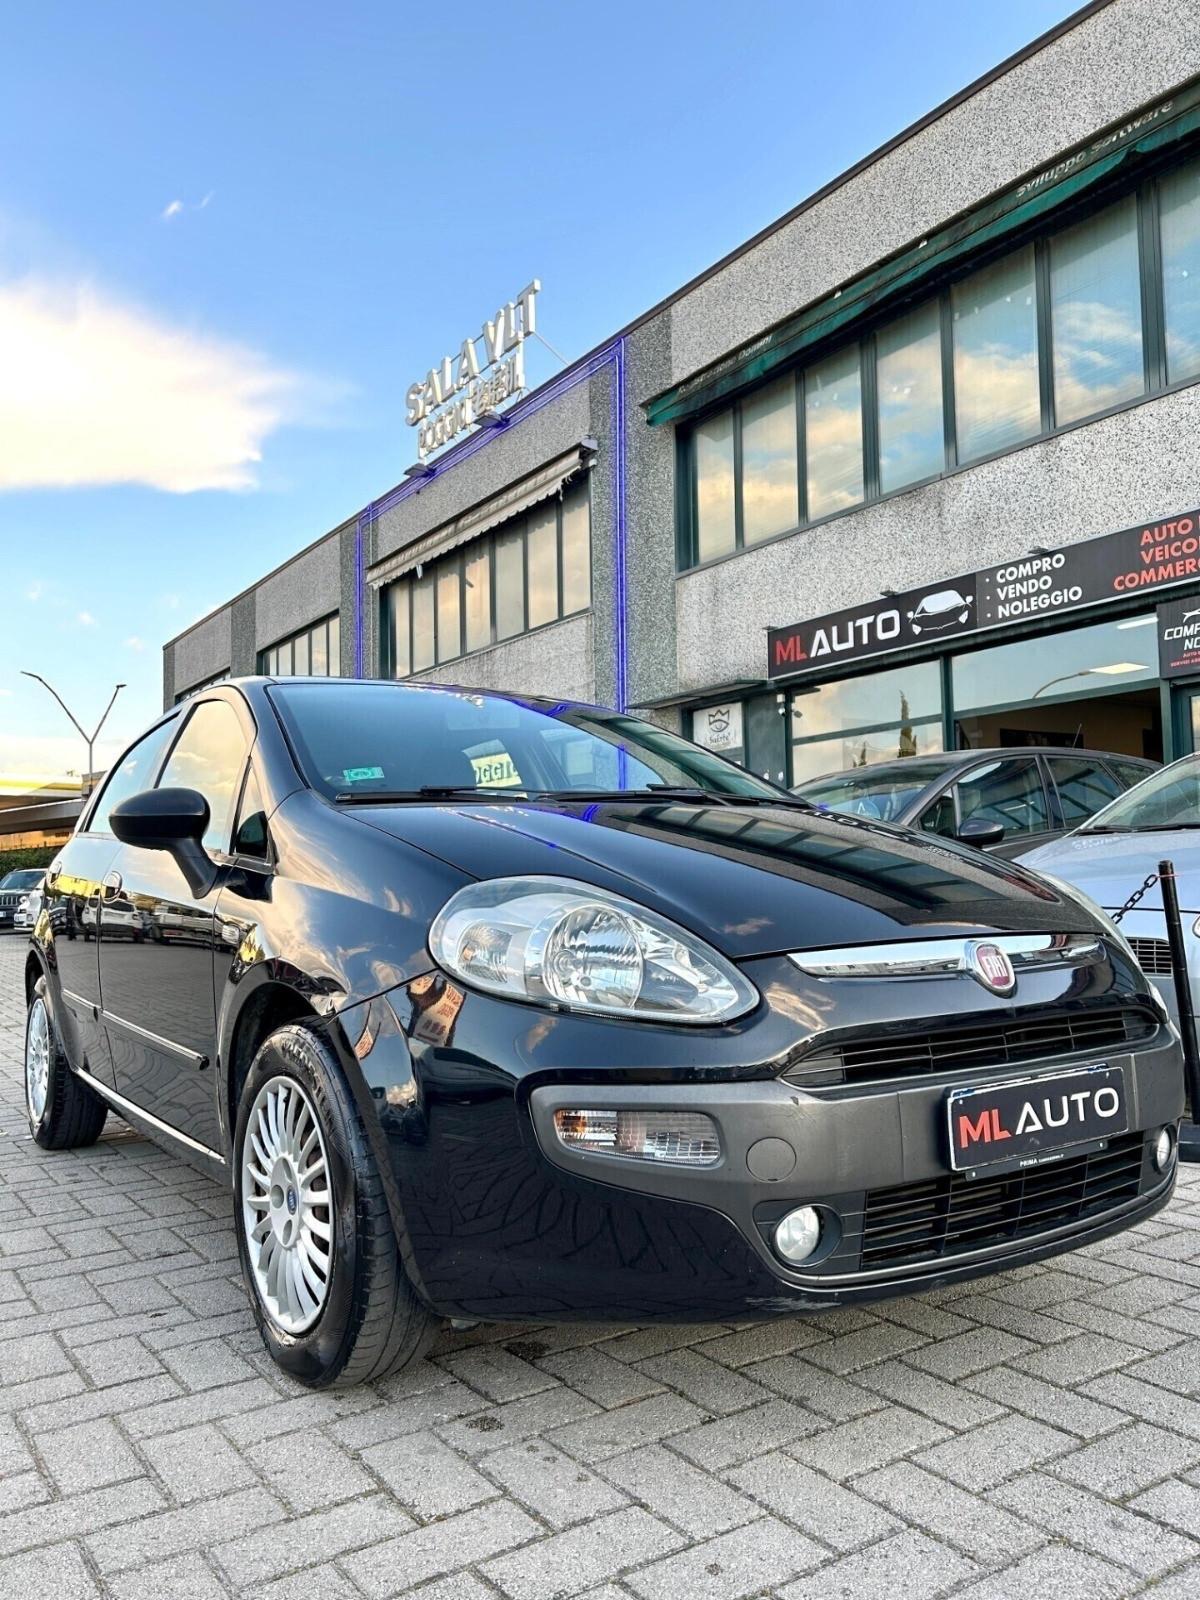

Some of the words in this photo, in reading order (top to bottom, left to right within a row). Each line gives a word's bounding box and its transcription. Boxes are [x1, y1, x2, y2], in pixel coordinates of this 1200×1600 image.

[1016, 152, 1086, 198] Sviluppo
[405, 338, 480, 428] SALA
[482, 278, 541, 366] VLT
[1140, 518, 1193, 546] AUTO
[1140, 536, 1200, 565] VEICO
[996, 553, 1066, 584] COMPRO
[1113, 558, 1200, 591] COMMER
[996, 575, 1052, 601] VENDO
[997, 586, 1083, 619] NOLEGGIO
[776, 635, 808, 666] ML
[810, 609, 900, 658] AUTO
[982, 954, 1009, 977] FIAT
[959, 1108, 1012, 1149] ML
[1015, 1087, 1120, 1135] AUTO
